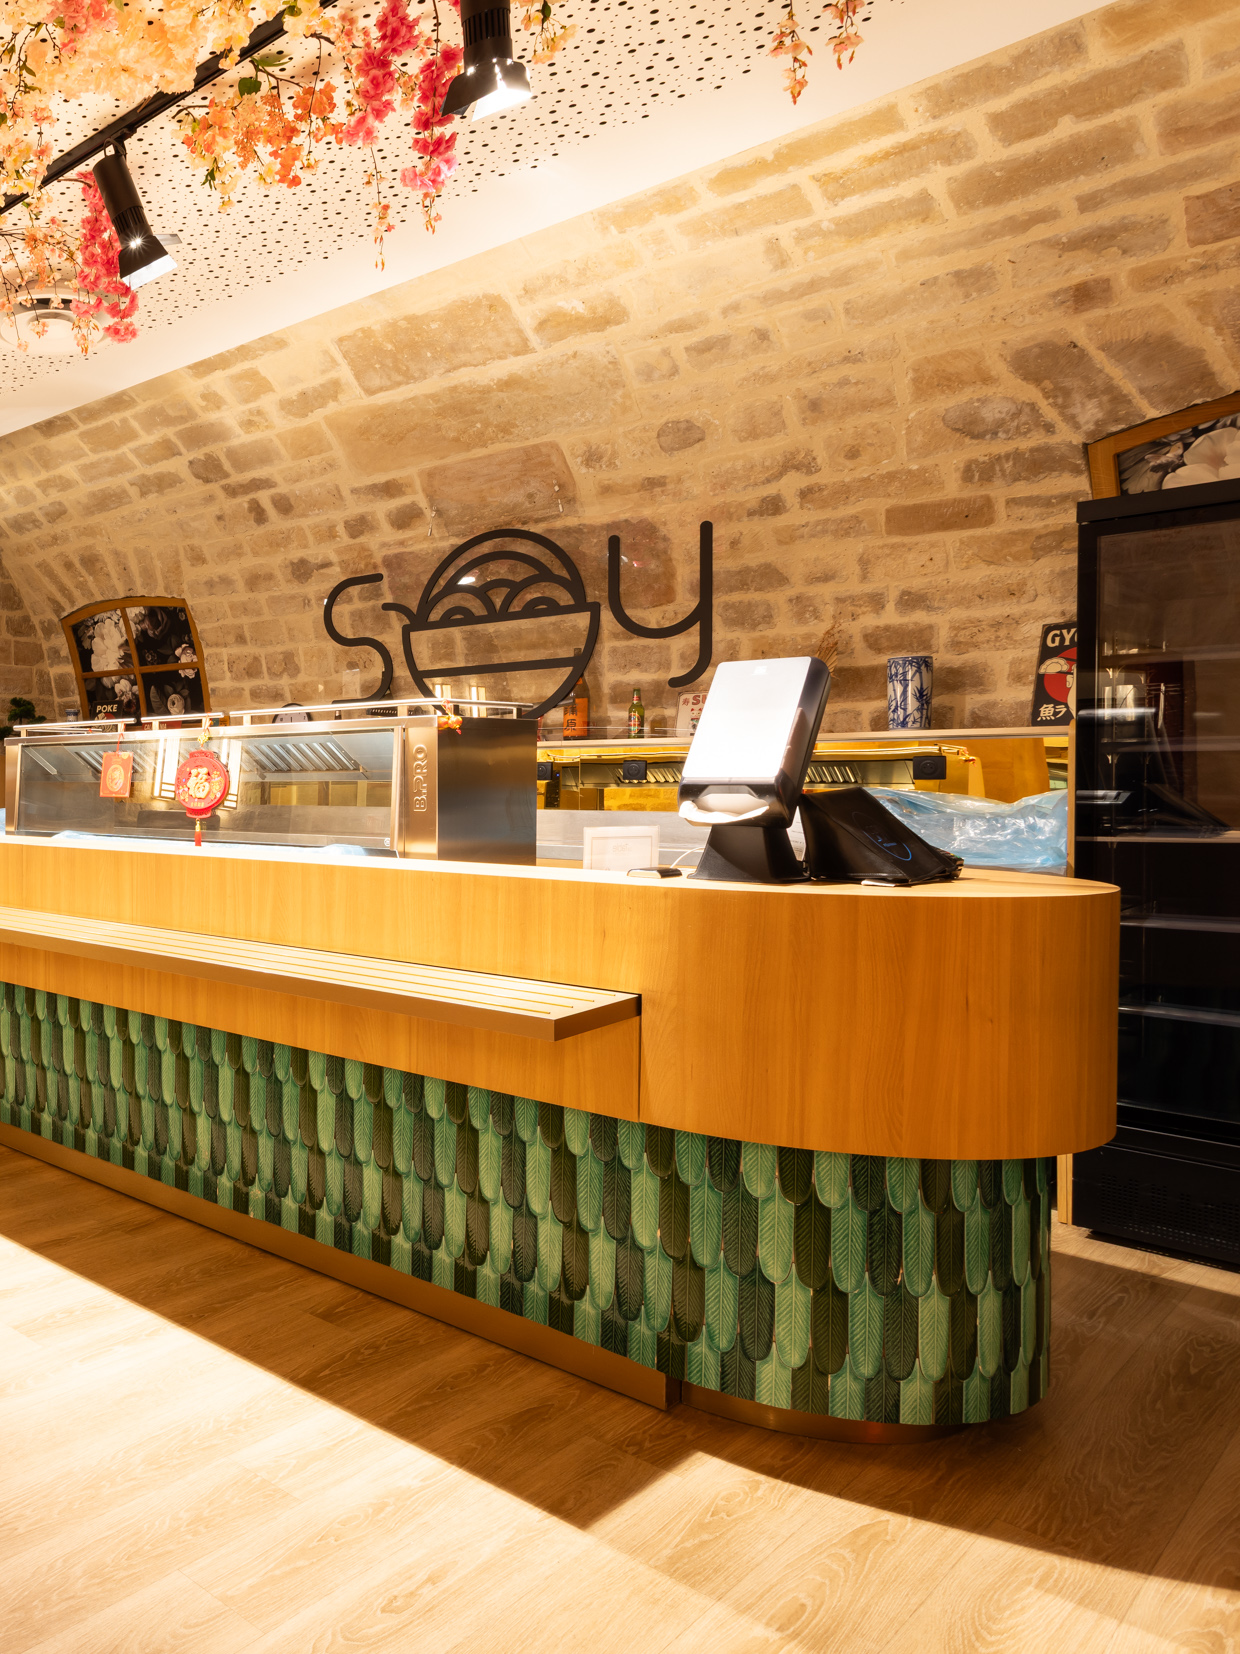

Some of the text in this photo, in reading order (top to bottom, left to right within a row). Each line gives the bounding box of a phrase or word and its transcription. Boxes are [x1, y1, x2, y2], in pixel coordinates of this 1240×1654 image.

[1046, 627, 1077, 648] GY
[96, 704, 118, 713] POKE
[187, 766, 210, 799] 福
